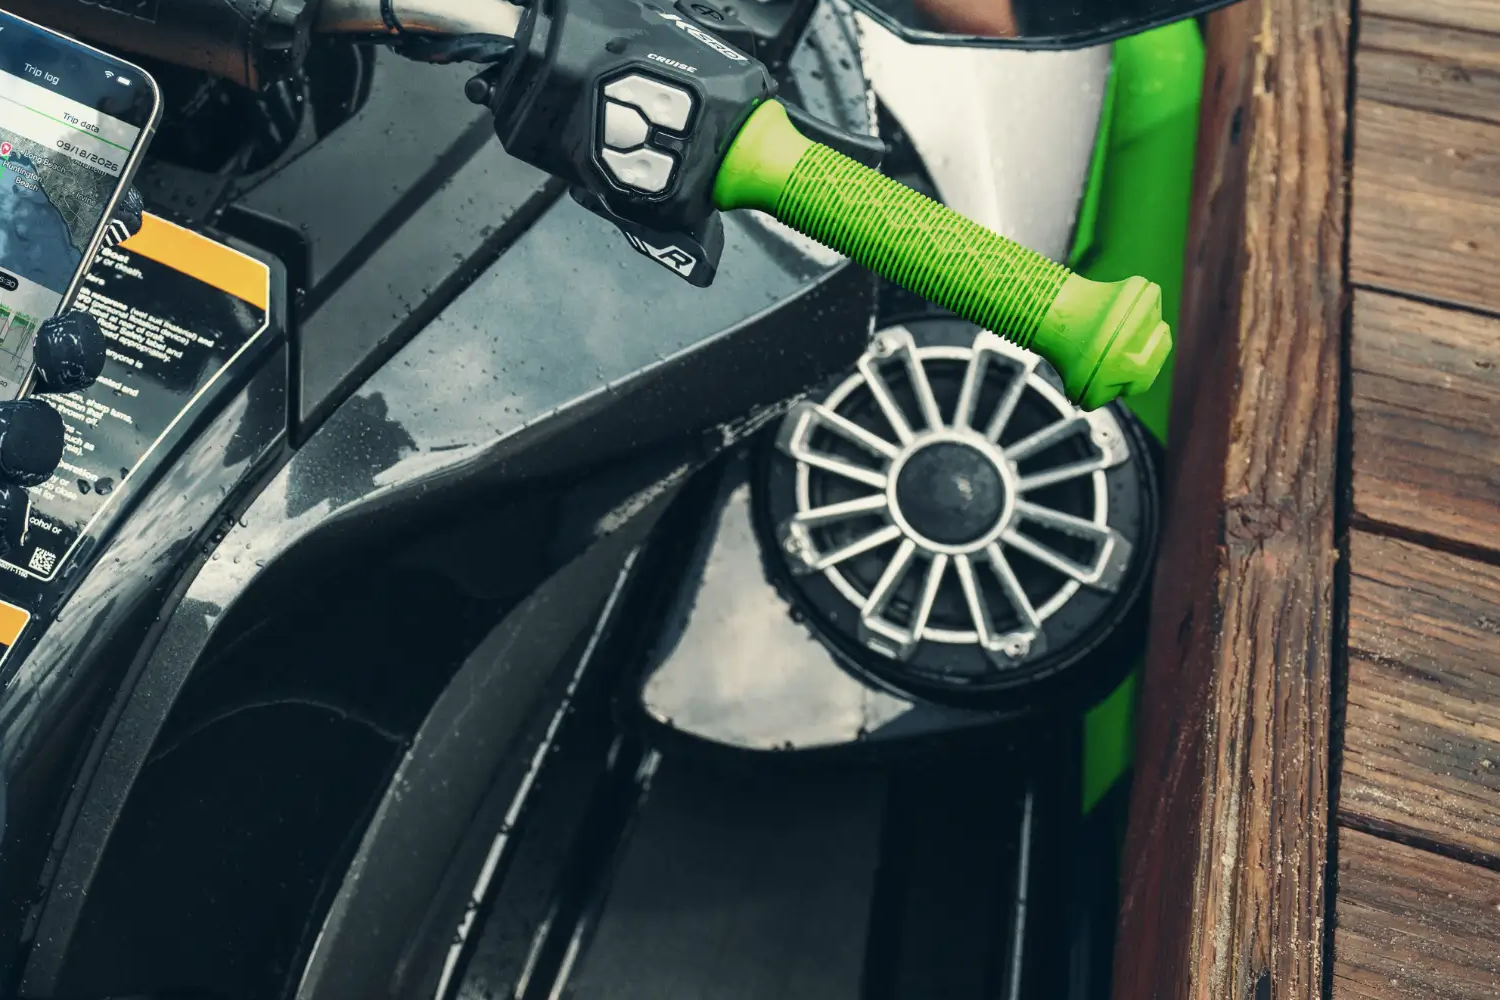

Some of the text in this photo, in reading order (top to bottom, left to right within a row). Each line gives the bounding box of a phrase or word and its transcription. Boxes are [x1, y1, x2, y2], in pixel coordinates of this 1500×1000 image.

[647, 53, 698, 73] CRUISE
[24, 62, 60, 86] Trip log
[63, 112, 100, 134] Trip data
[24, 150, 67, 174] Long Beach
[56, 140, 119, 172] 09/18/2026
[3, 161, 42, 182] Huntington
[15, 176, 39, 192] Beach
[76, 193, 97, 205] Irvine
[29, 516, 62, 535] cohol or
